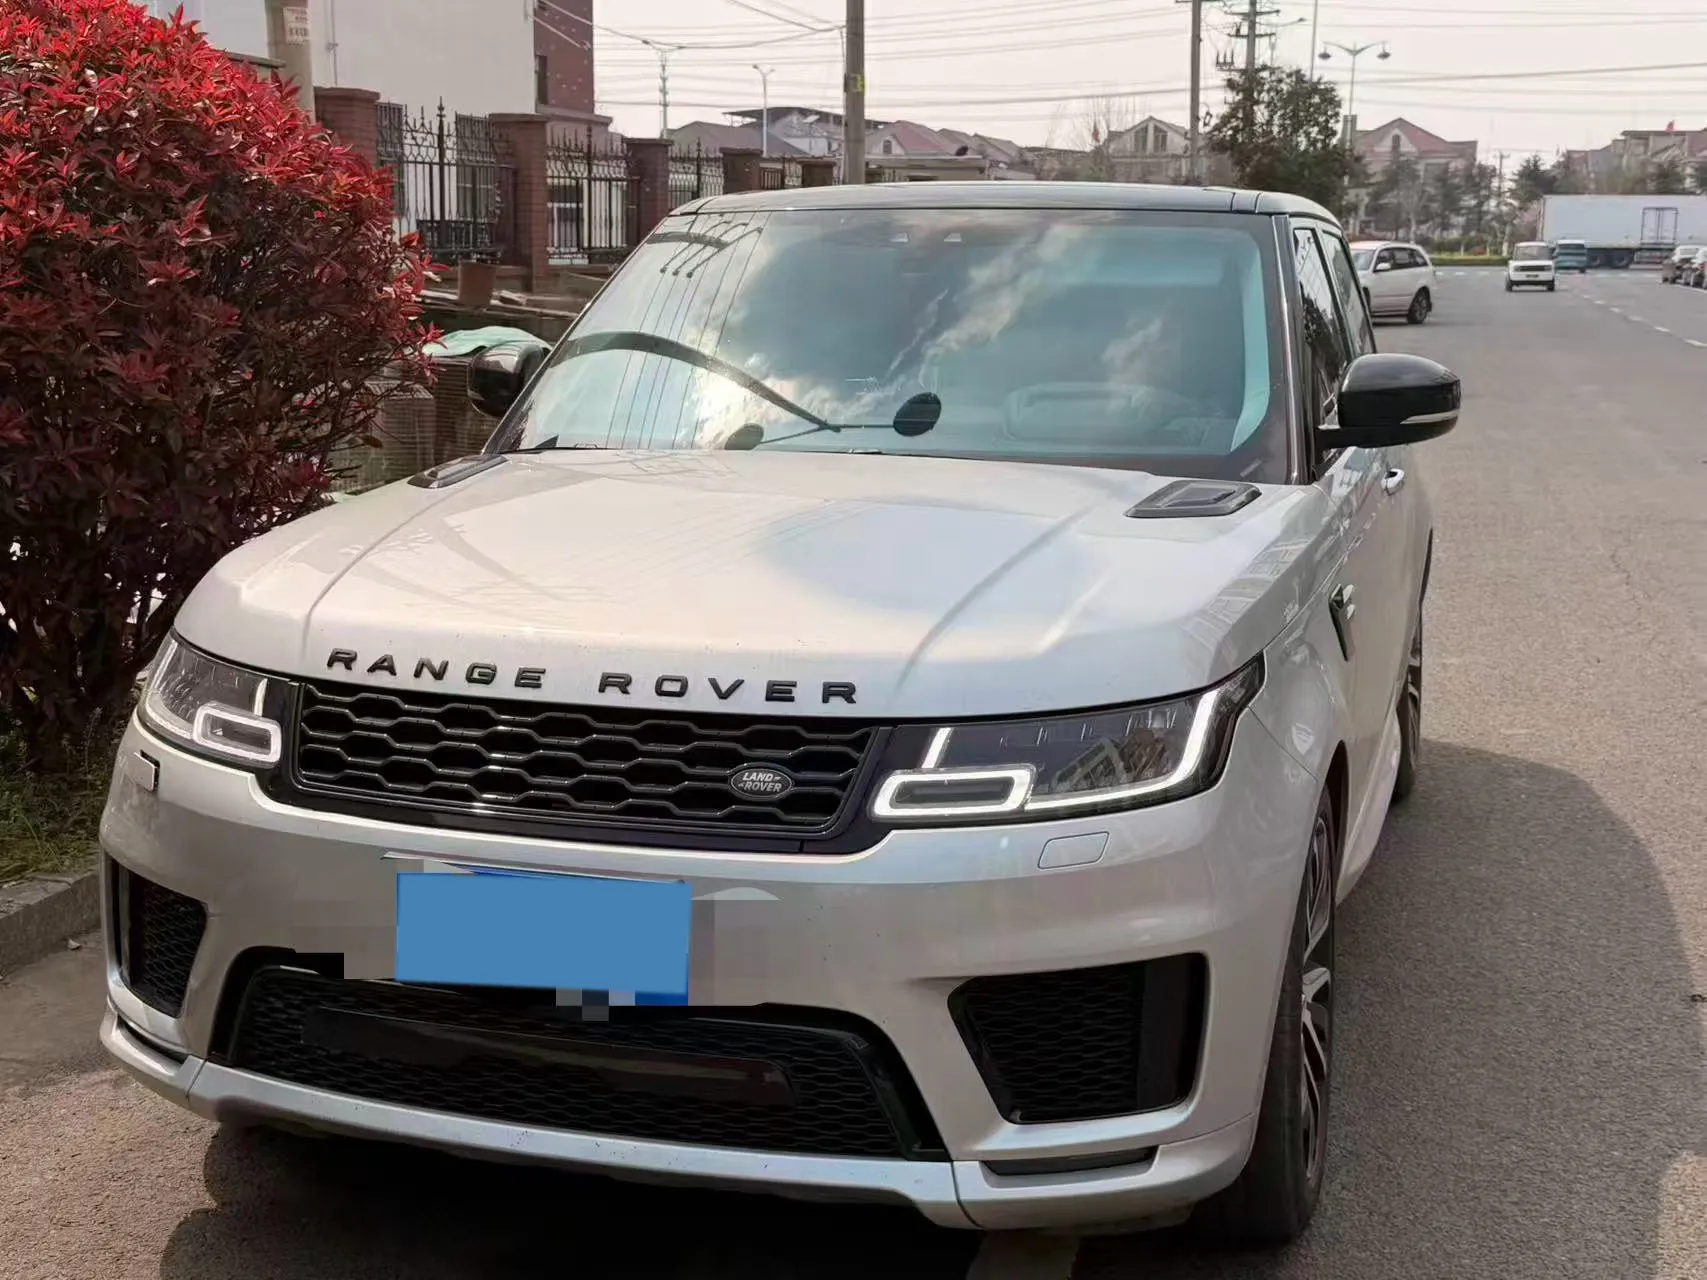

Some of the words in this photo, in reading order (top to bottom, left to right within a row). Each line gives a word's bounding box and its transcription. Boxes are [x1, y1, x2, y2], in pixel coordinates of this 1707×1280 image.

[327, 648, 546, 688] RANGE
[598, 672, 857, 704] ROVER
[743, 781, 782, 793] ROVER
